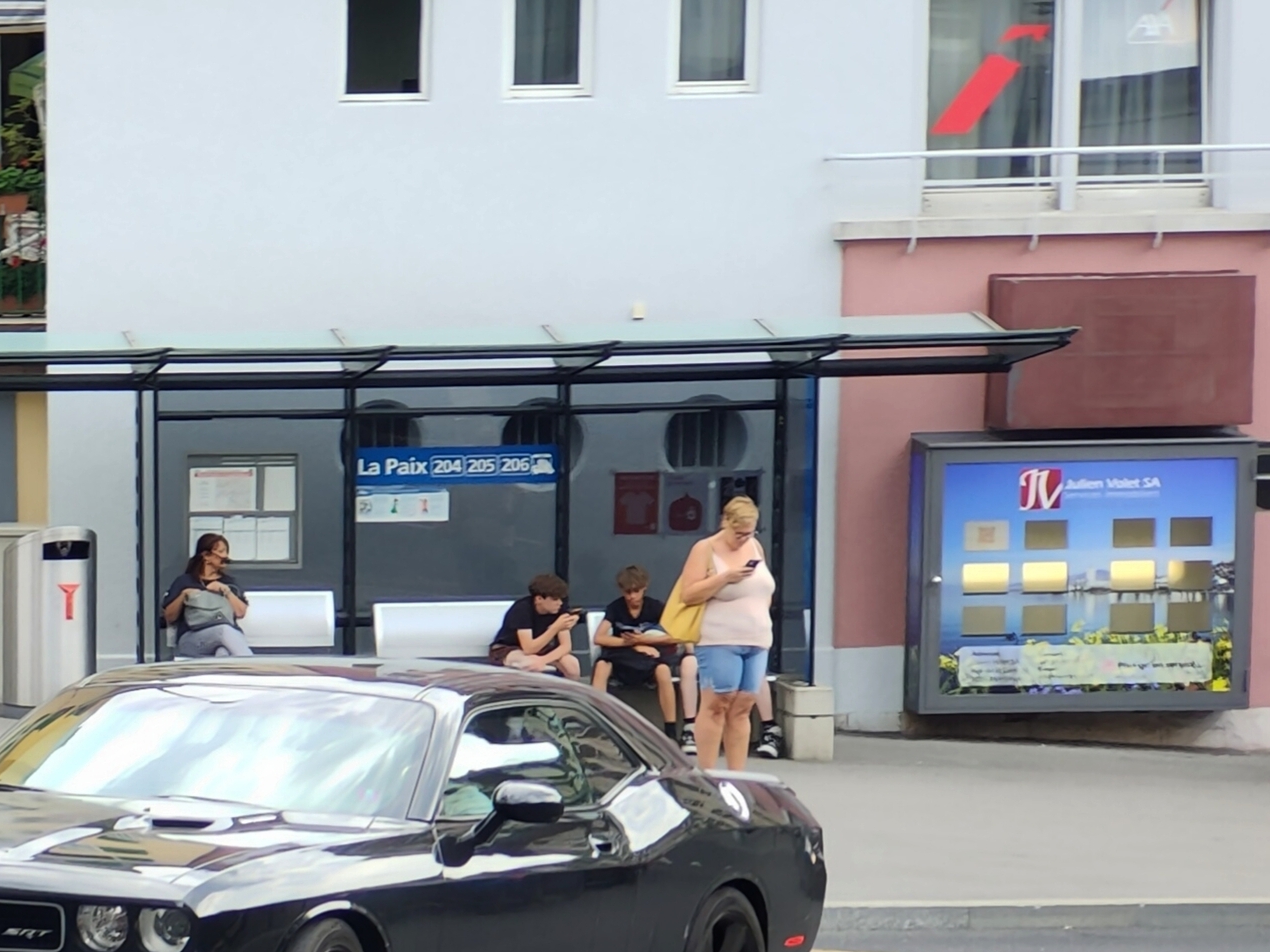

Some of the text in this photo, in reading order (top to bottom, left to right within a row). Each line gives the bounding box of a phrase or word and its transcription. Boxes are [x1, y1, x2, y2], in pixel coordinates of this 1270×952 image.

[357, 457, 530, 476] La Paix 204 205 206
[1, 927, 53, 939] SRT
